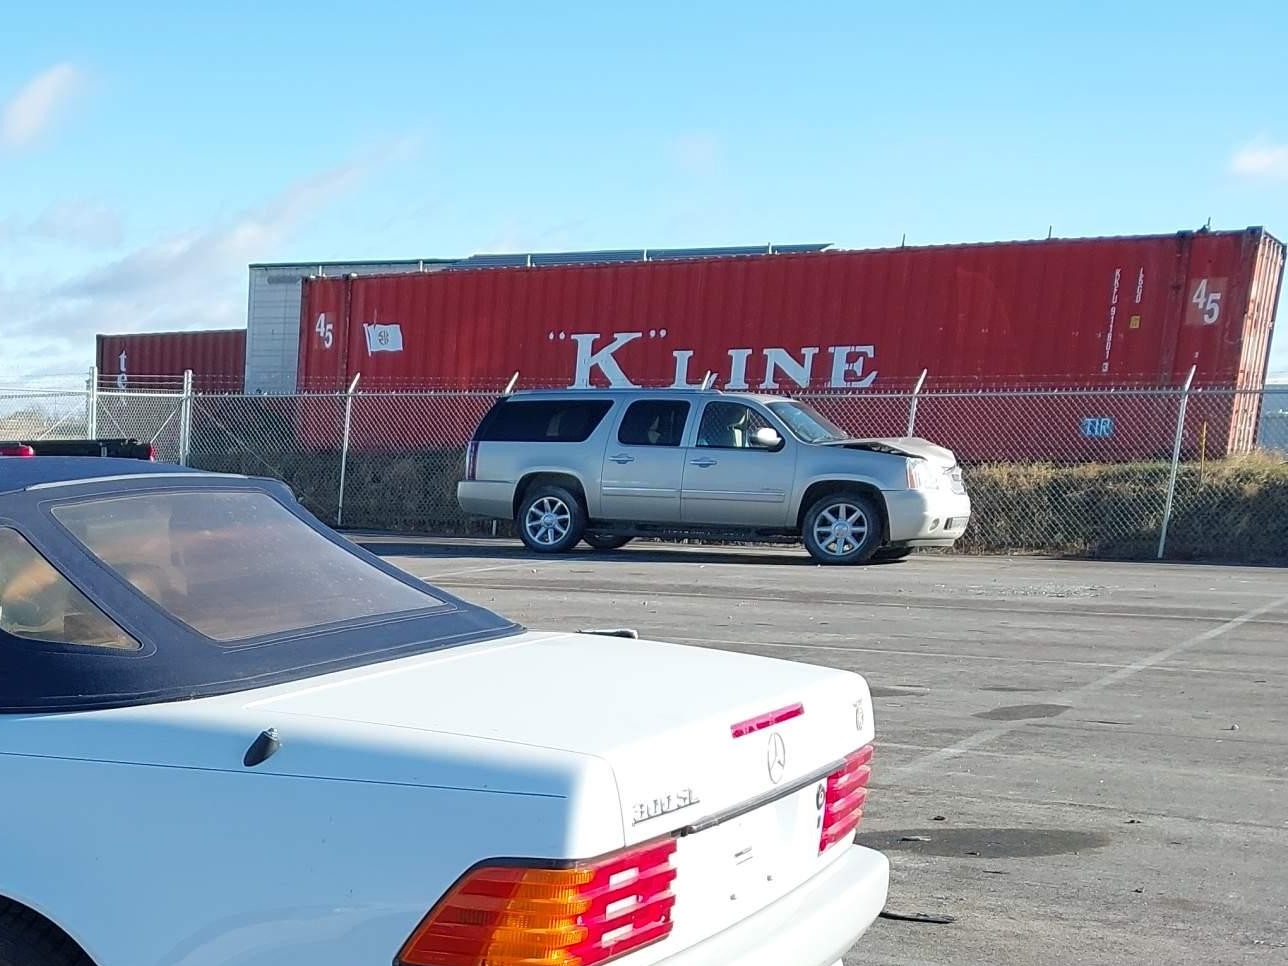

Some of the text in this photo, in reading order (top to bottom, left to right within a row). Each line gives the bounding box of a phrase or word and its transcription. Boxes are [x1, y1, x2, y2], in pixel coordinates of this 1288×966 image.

[1192, 279, 1222, 324] 45
[315, 312, 334, 349] 45
[671, 345, 879, 390] LINE
